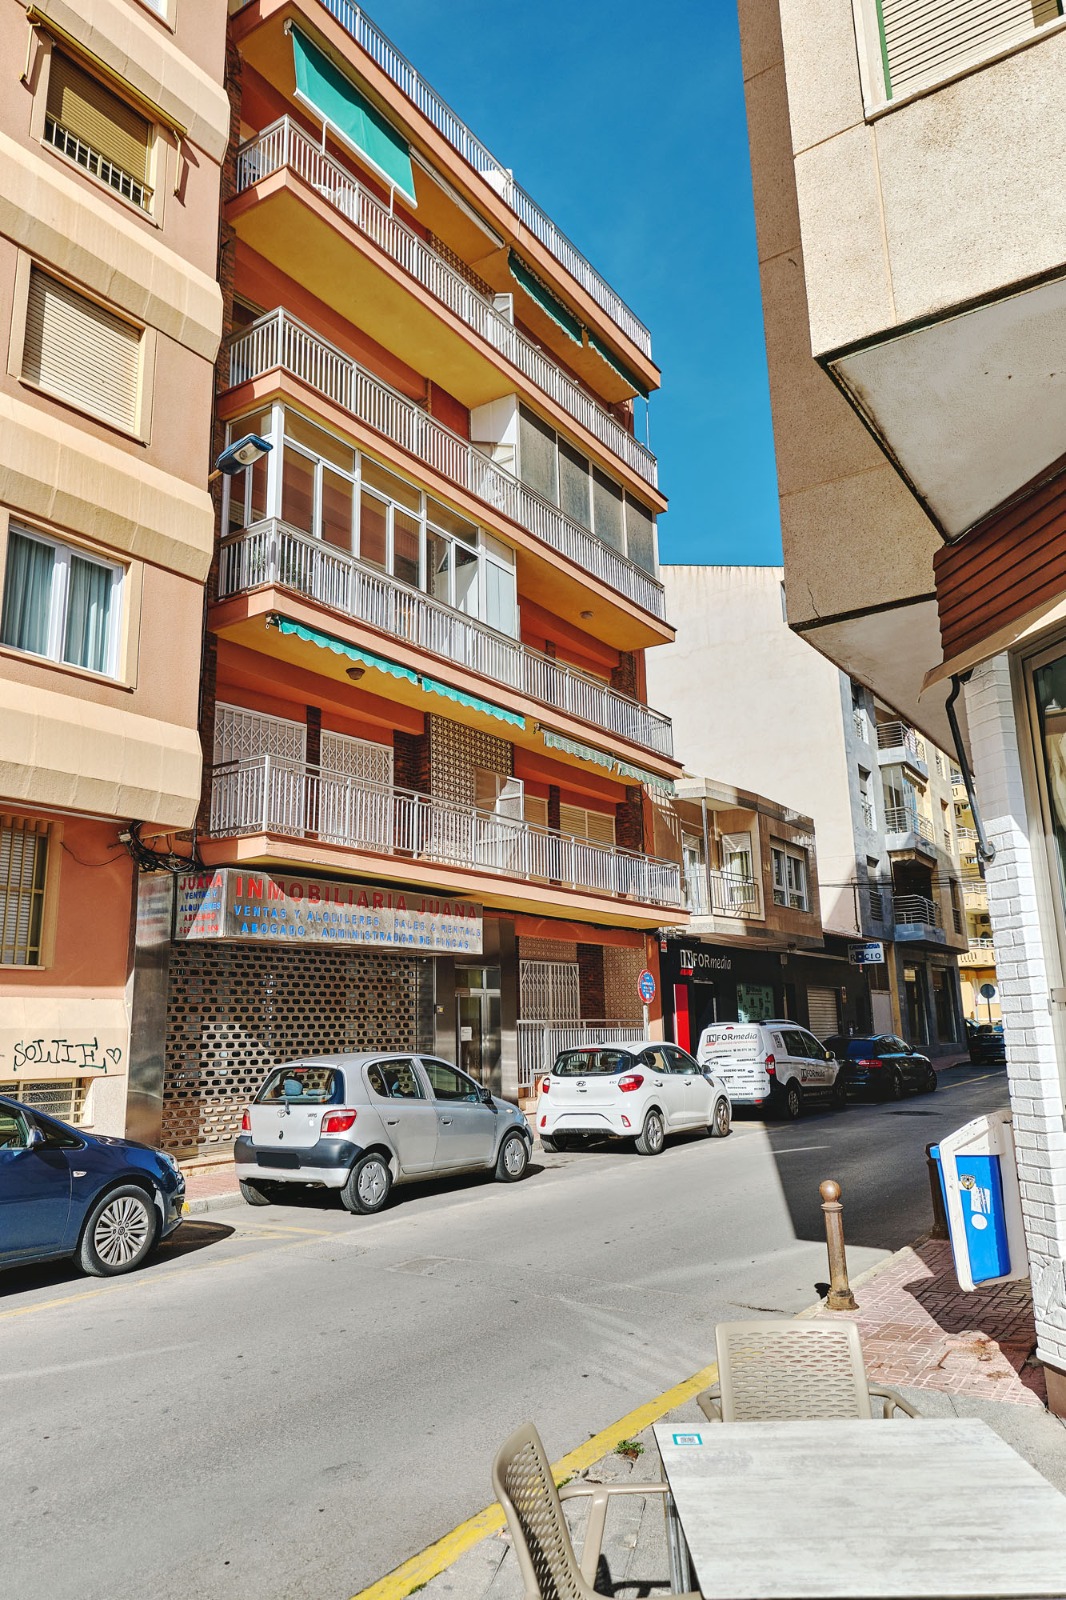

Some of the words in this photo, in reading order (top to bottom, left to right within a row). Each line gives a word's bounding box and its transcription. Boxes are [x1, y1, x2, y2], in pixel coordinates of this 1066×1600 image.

[179, 874, 223, 890] JUANA
[185, 890, 210, 900] VENTAS
[236, 876, 407, 912] INMOBILIARIA
[417, 898, 477, 921] JUANA
[180, 902, 221, 912] ALQUILERES
[184, 912, 216, 922] ABOGADO
[234, 904, 287, 919] VENTAS
[294, 909, 301, 920] Y
[307, 910, 380, 926] ALQUILERES
[394, 918, 425, 931] SALES
[431, 922, 436, 932] &
[441, 924, 481, 937] RENTALS
[241, 921, 305, 937] ABOGADO
[322, 927, 414, 943] ADMINISTRADOR
[419, 935, 431, 945] DE
[436, 937, 469, 949] FINCAS
[706, 1032, 758, 1044] INFORmedia
